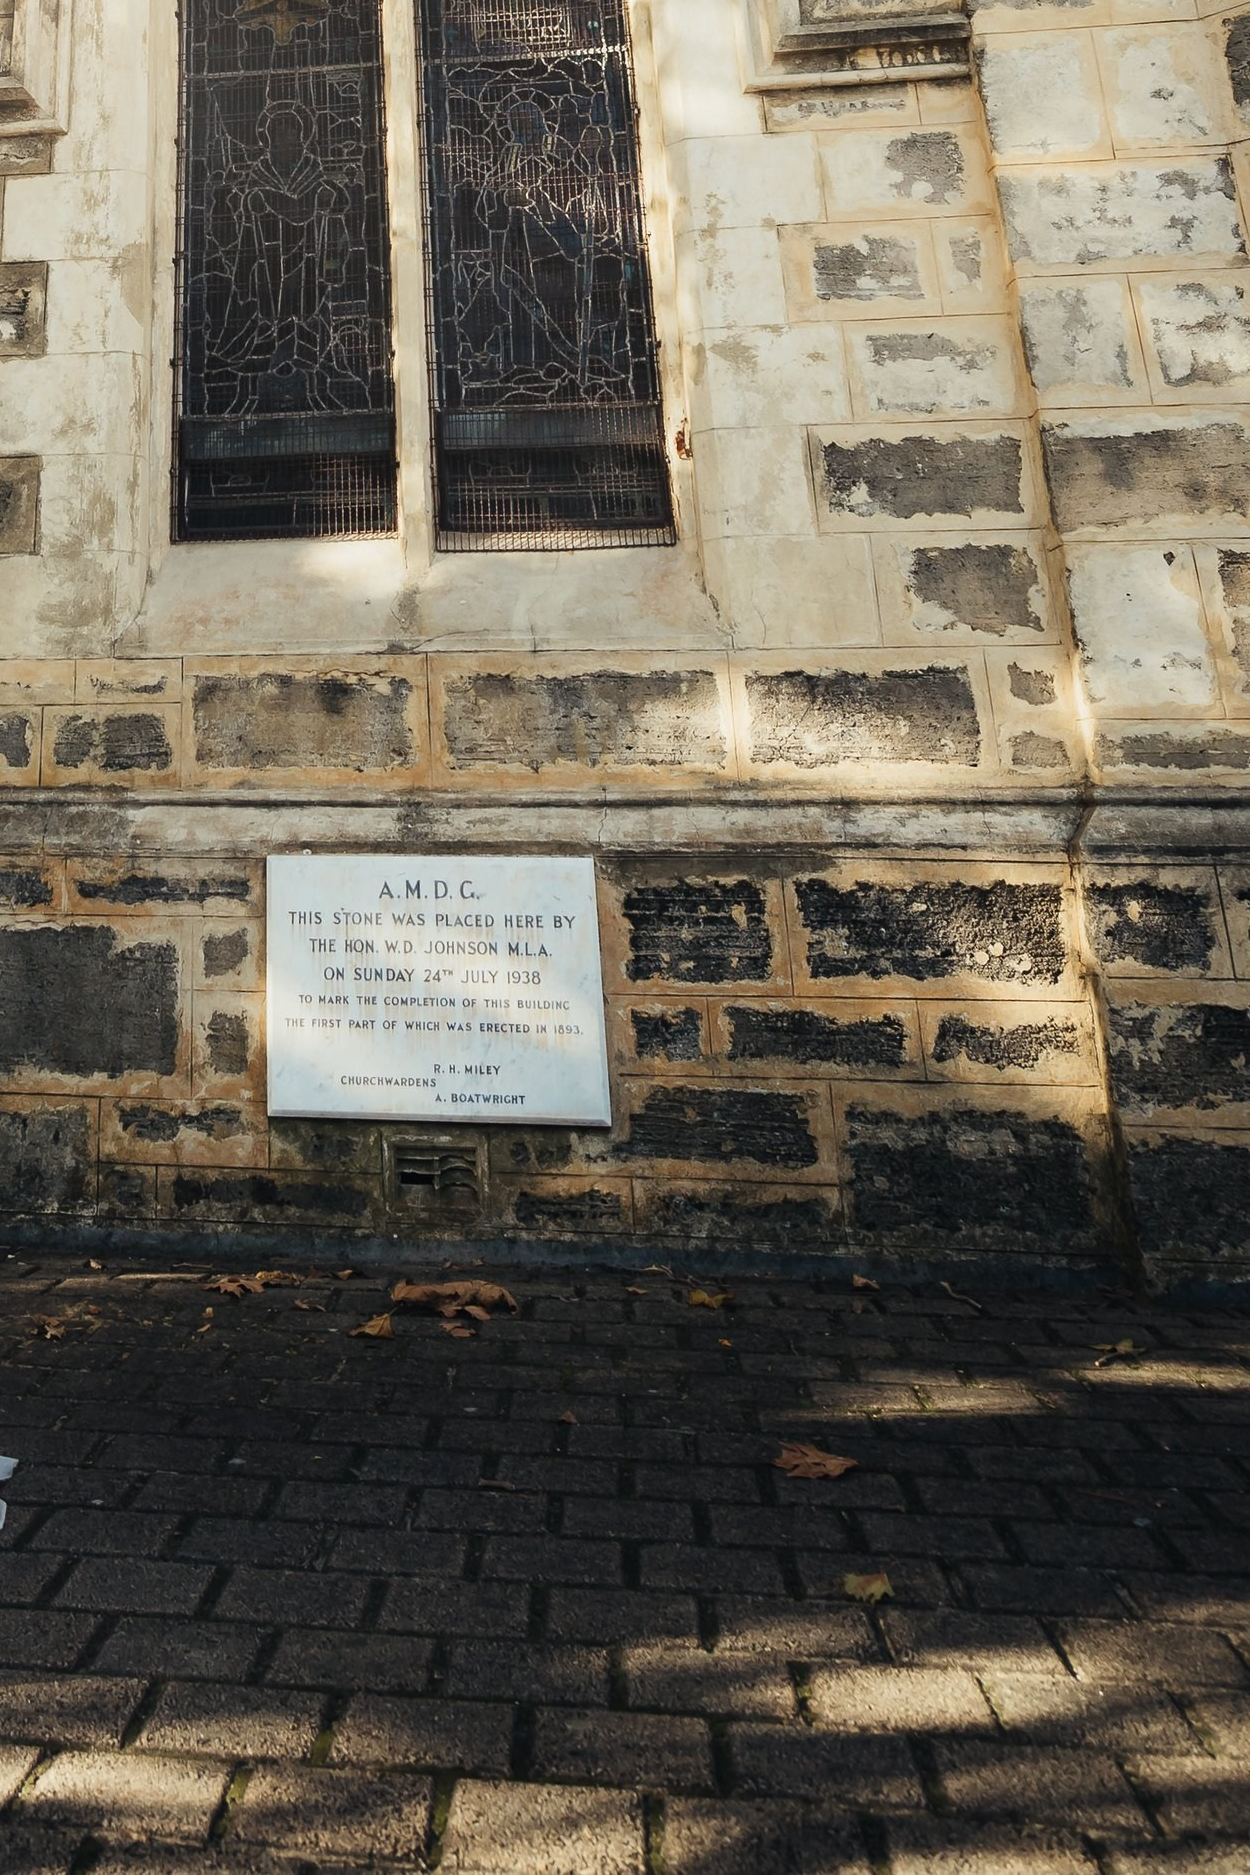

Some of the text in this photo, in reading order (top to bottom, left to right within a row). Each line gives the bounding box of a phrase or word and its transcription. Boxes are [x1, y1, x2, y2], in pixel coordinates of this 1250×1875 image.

[289, 911, 576, 929] THIS STONE WAS PLACED HERE BY
[309, 938, 336, 953] THE
[345, 939, 379, 954] HON.
[424, 940, 498, 955] JOHNSON
[508, 942, 552, 957] M.L.A.
[324, 966, 345, 981] ON
[354, 967, 415, 982] SUNDAY
[461, 969, 499, 984] JULY
[507, 970, 542, 985] 1938
[298, 994, 570, 1010] TO MARK THE COMPLETION OF THIS BUILDING
[285, 1017, 305, 1027] THE
[311, 1018, 342, 1028] FIRST
[348, 1019, 376, 1029] PART
[382, 1020, 398, 1030] OF
[404, 1020, 440, 1031] WHICH
[446, 1022, 472, 1032] WAS
[479, 1022, 530, 1033] ERECTED
[536, 1024, 547, 1034] IN
[434, 1063, 501, 1075] R. H. MILEY
[340, 1075, 437, 1088] CHURCHWARDENS
[435, 1093, 526, 1105] A. BOATWRIGHT
